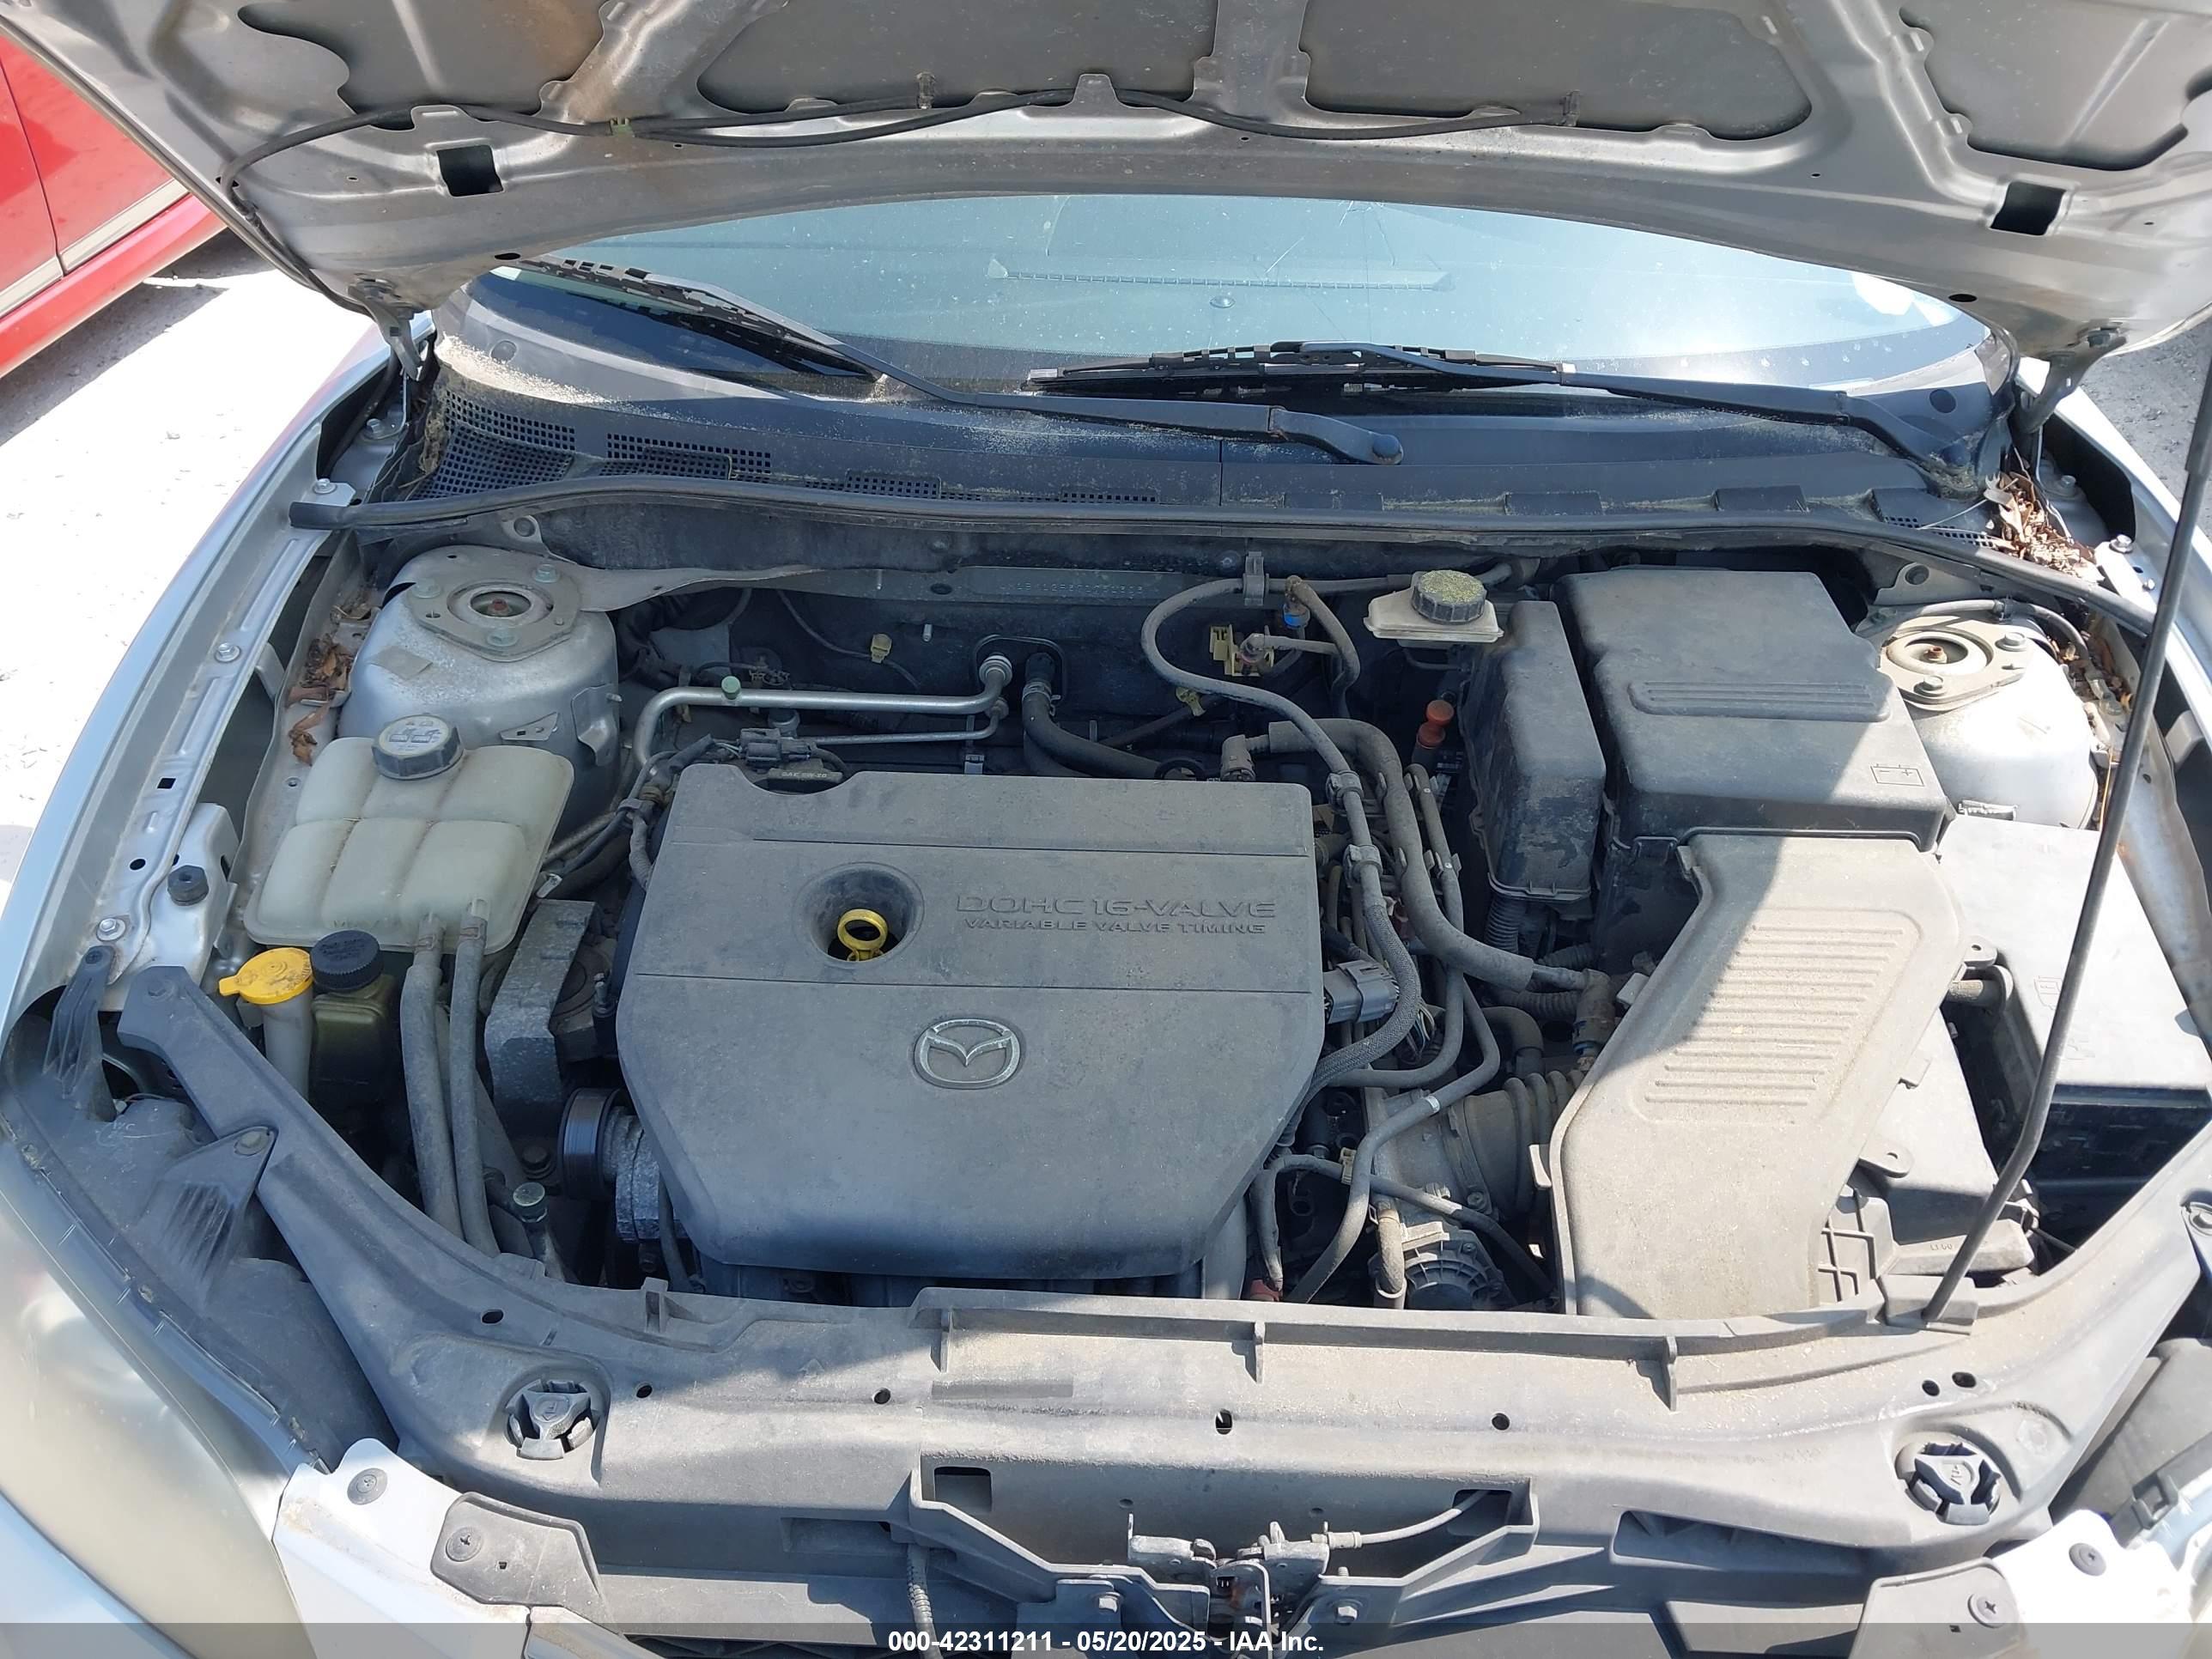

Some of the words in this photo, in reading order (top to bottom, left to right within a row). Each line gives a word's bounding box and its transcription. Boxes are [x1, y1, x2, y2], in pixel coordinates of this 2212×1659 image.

[956, 893, 1085, 915] DOHC
[1091, 897, 1277, 919] 16-VALVE
[963, 918, 1088, 931] VARIABLE
[1091, 921, 1170, 933] VALVE
[1177, 922, 1267, 934] TIMING
